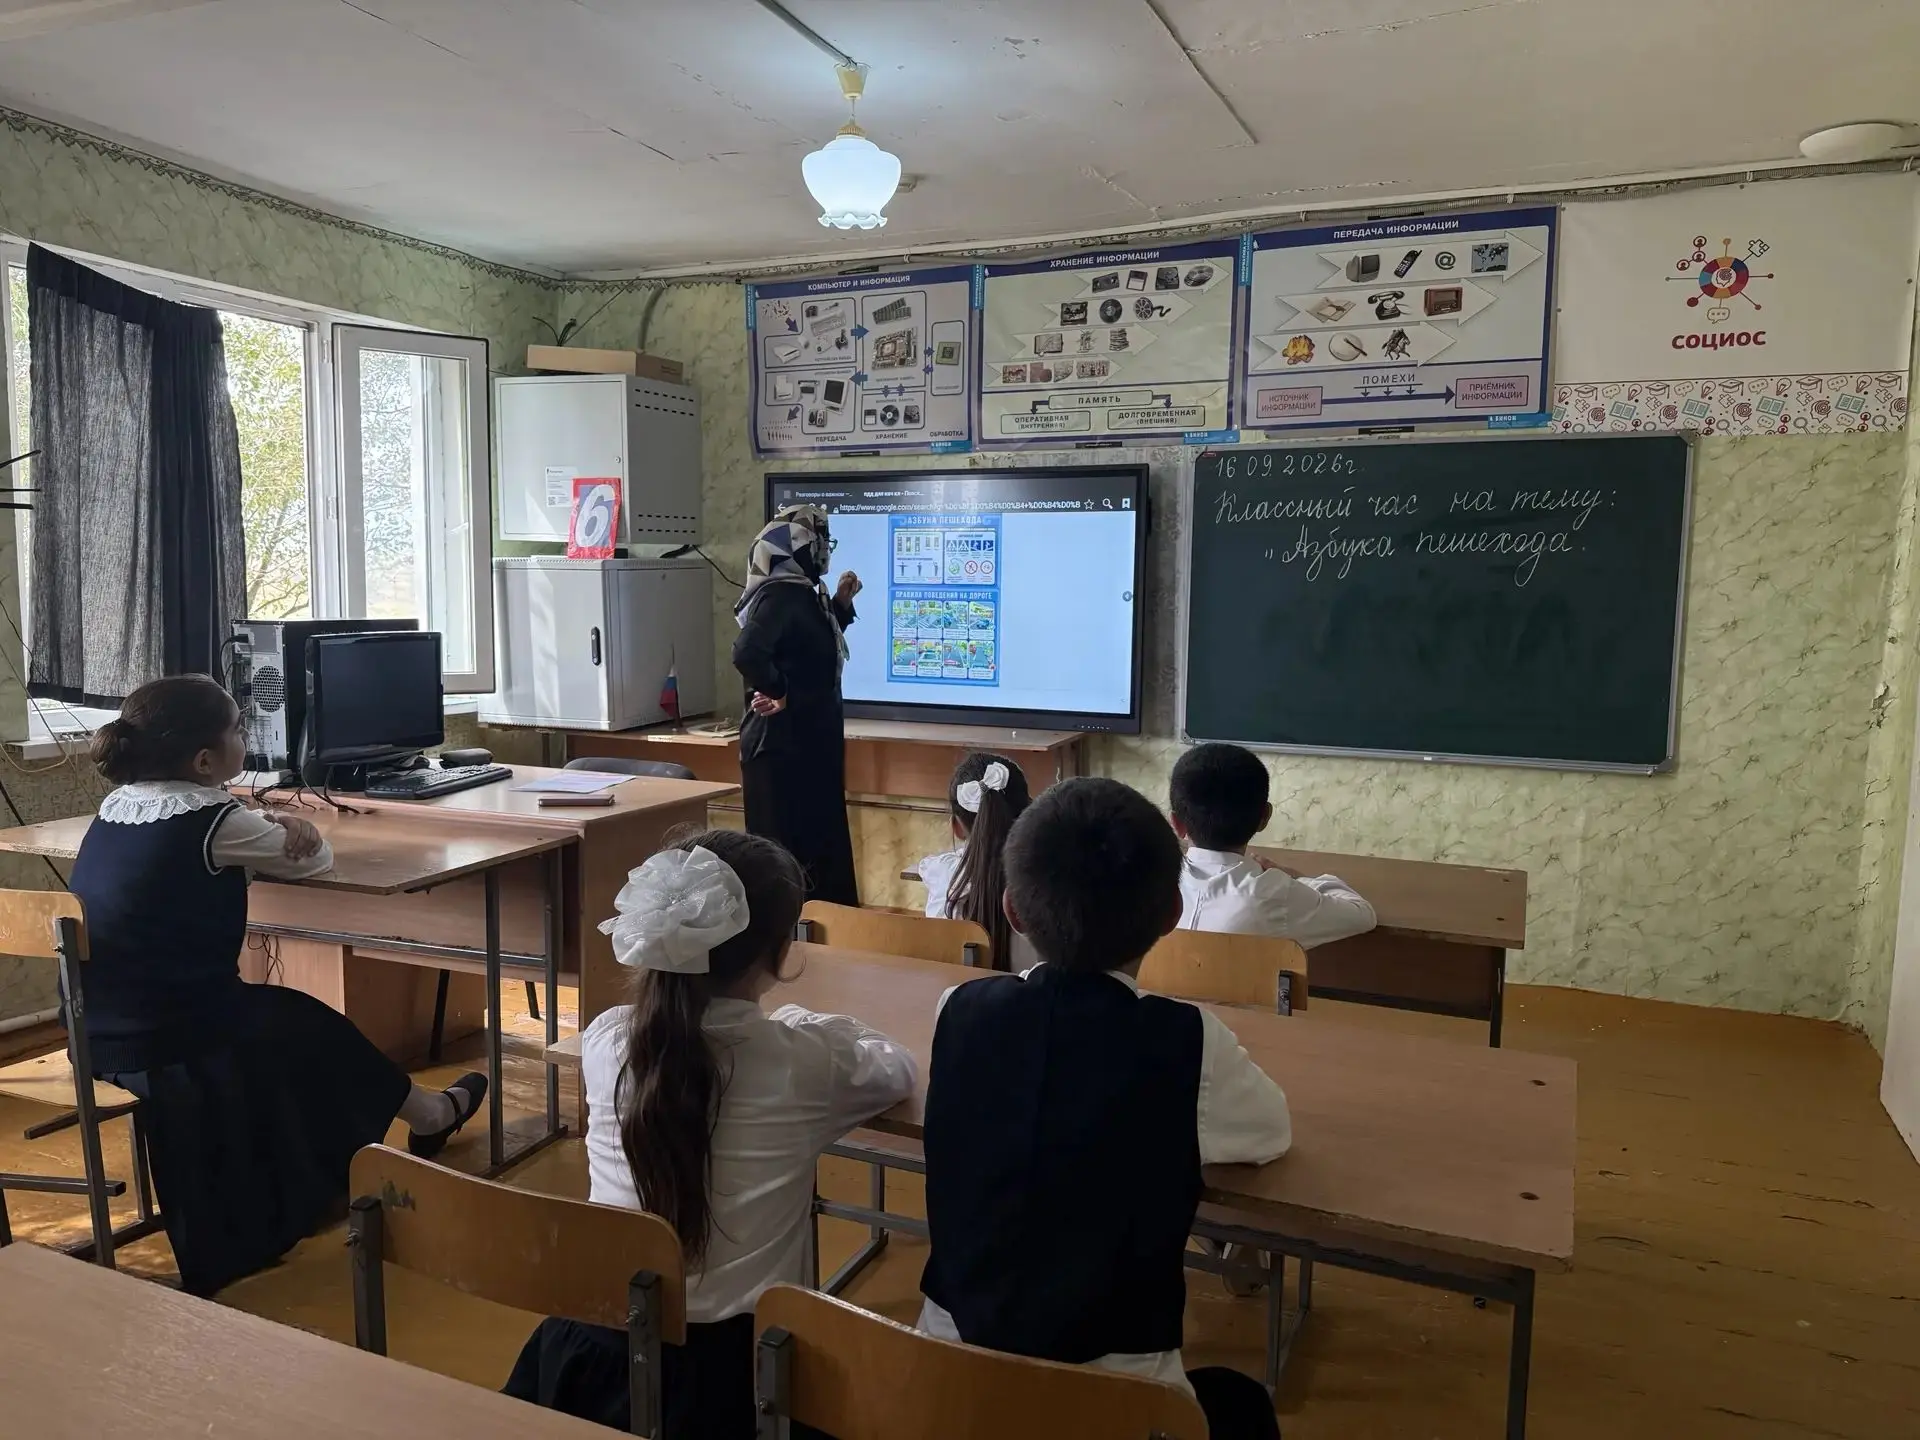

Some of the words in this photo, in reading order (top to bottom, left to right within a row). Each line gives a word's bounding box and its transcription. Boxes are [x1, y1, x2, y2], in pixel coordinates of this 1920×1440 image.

[1333, 227, 1384, 239] ПЕРЕДАЧА
[1386, 220, 1459, 234] ИНФОРМАЦИИ
[1050, 256, 1094, 268] ХРАНЕНИЕ
[1096, 251, 1160, 264] ИНФОРМАЦИИ
[807, 280, 851, 291] КОМПЬЮТЕР
[852, 279, 858, 287] И
[860, 275, 911, 286] ИНФОРМАЦИЯ
[1362, 374, 1416, 385] ПОМЕХИ
[1469, 381, 1516, 391] ПРИЁМНИК
[1078, 396, 1121, 404] ПАМЯТЬ
[1268, 392, 1309, 403] ИСТОЧНИК
[1461, 391, 1523, 401] ИНФОРМАЦИИ
[1261, 402, 1316, 412] ИНФОРМАЦИИ
[1014, 415, 1069, 423] ОПЕРАТИВНАЯ
[1118, 409, 1197, 420] ДОЛГОВРЕМЕННАЯ
[875, 432, 908, 440] ХРАНЕНИЕ
[929, 430, 964, 438] ОБРАБОТКА
[1214, 486, 1356, 524] Классный
[1368, 493, 1419, 517] час
[1450, 489, 1497, 513] на
[574, 484, 616, 548] 6
[940, 515, 981, 525] ПЕШЕХОДА
[895, 591, 922, 599] ПРАВИЛА
[924, 591, 958, 600] ПОВЕДЕНИЯ
[959, 592, 968, 600] НА
[969, 592, 992, 600] ДОРОГЕ
